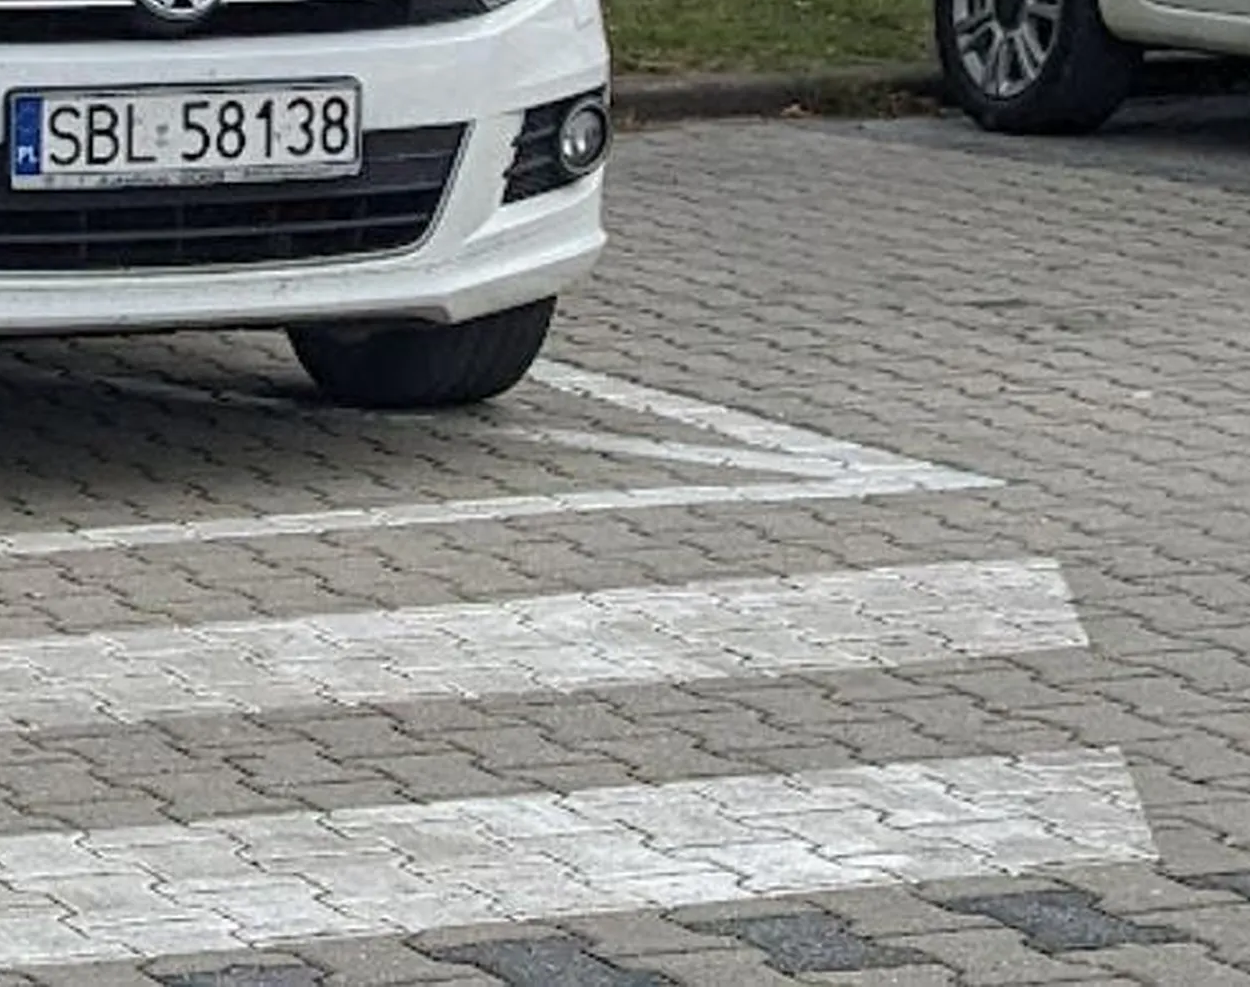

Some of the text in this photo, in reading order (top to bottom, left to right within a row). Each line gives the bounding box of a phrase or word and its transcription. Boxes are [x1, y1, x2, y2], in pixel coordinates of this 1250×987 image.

[48, 96, 350, 166] SBL 58138
[17, 145, 37, 164] PL
